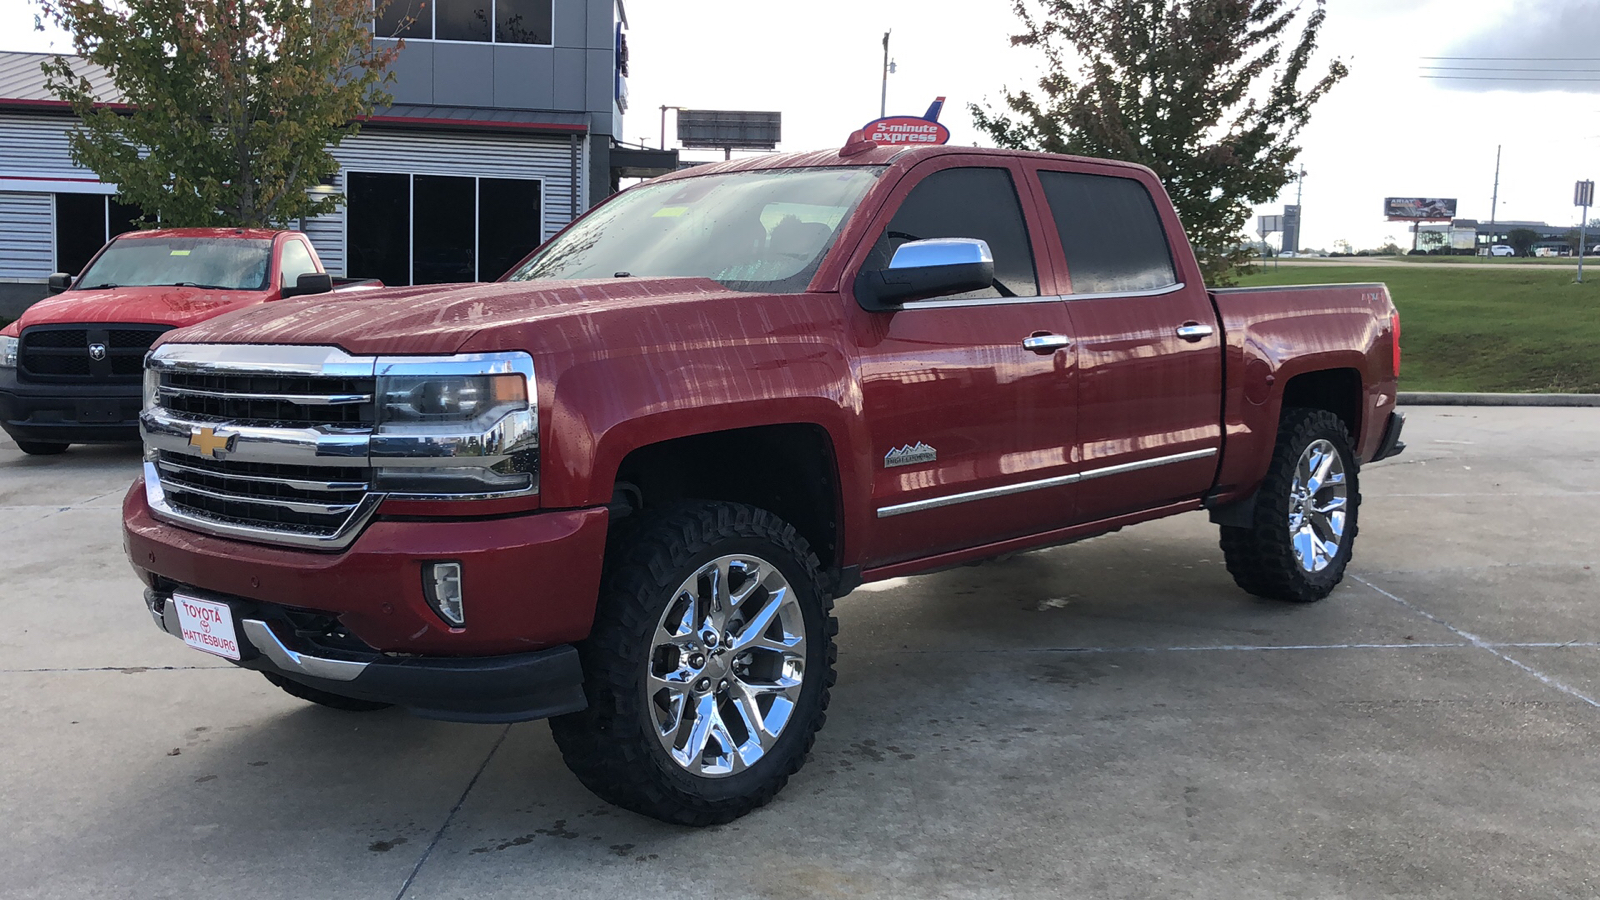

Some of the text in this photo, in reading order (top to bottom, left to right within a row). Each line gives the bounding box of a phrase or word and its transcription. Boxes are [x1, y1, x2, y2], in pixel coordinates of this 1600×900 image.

[877, 122, 938, 133] 5-minute
[872, 132, 937, 143] express
[183, 602, 222, 624] TOYOTA
[183, 628, 236, 652] HATTIESBURG
